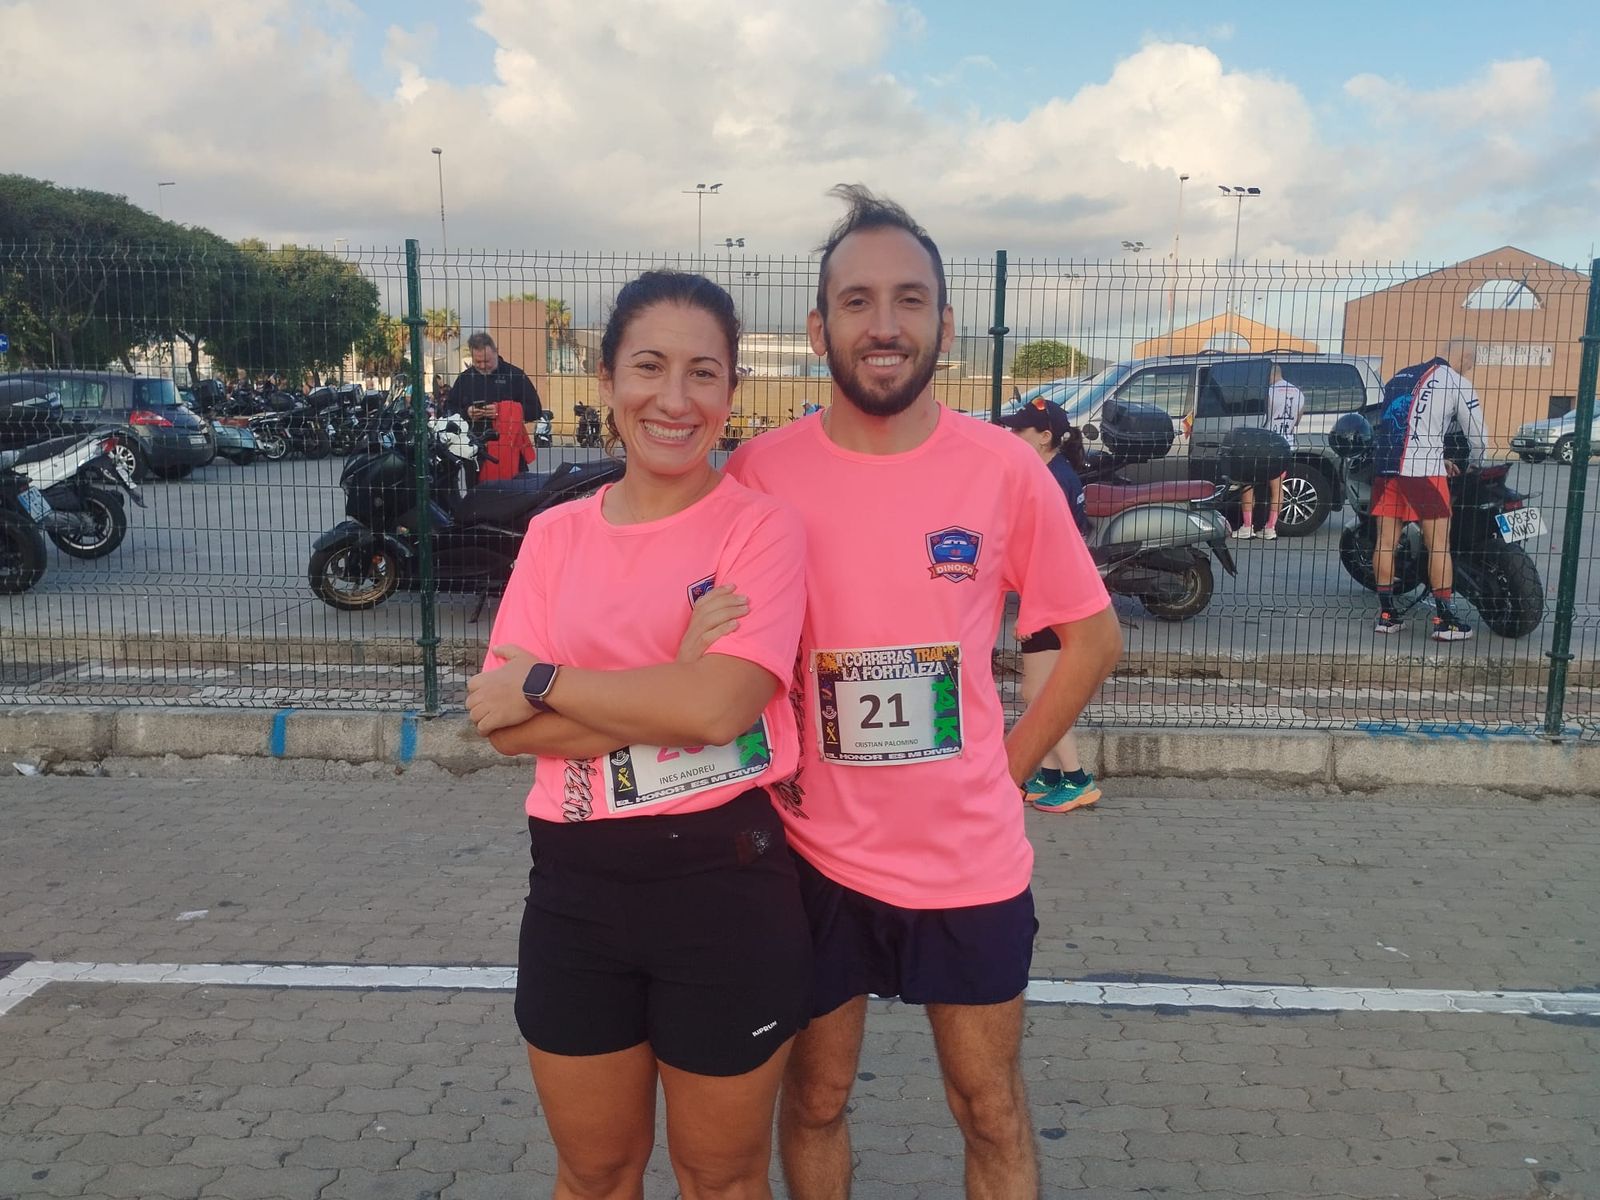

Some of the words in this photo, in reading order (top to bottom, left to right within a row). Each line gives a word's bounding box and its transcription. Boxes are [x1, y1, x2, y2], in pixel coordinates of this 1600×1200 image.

[1411, 379, 1439, 441] CEUTA
[936, 564, 974, 575] DINOCO
[842, 667, 861, 681] LA
[862, 661, 945, 681] FORTALEZA
[859, 693, 910, 729] 21
[840, 752, 883, 761] HONOR
[888, 752, 906, 760] ES
[907, 751, 922, 759] MI
[923, 746, 960, 757] DIVISA
[855, 740, 883, 749] CRISTIAN
[884, 738, 919, 748] PALOMINO
[636, 785, 686, 803] HONOR
[691, 779, 709, 788] ES
[711, 775, 728, 784] MI
[729, 763, 769, 779] DIVISA
[659, 774, 679, 785] INES
[680, 764, 716, 780] ANDREU
